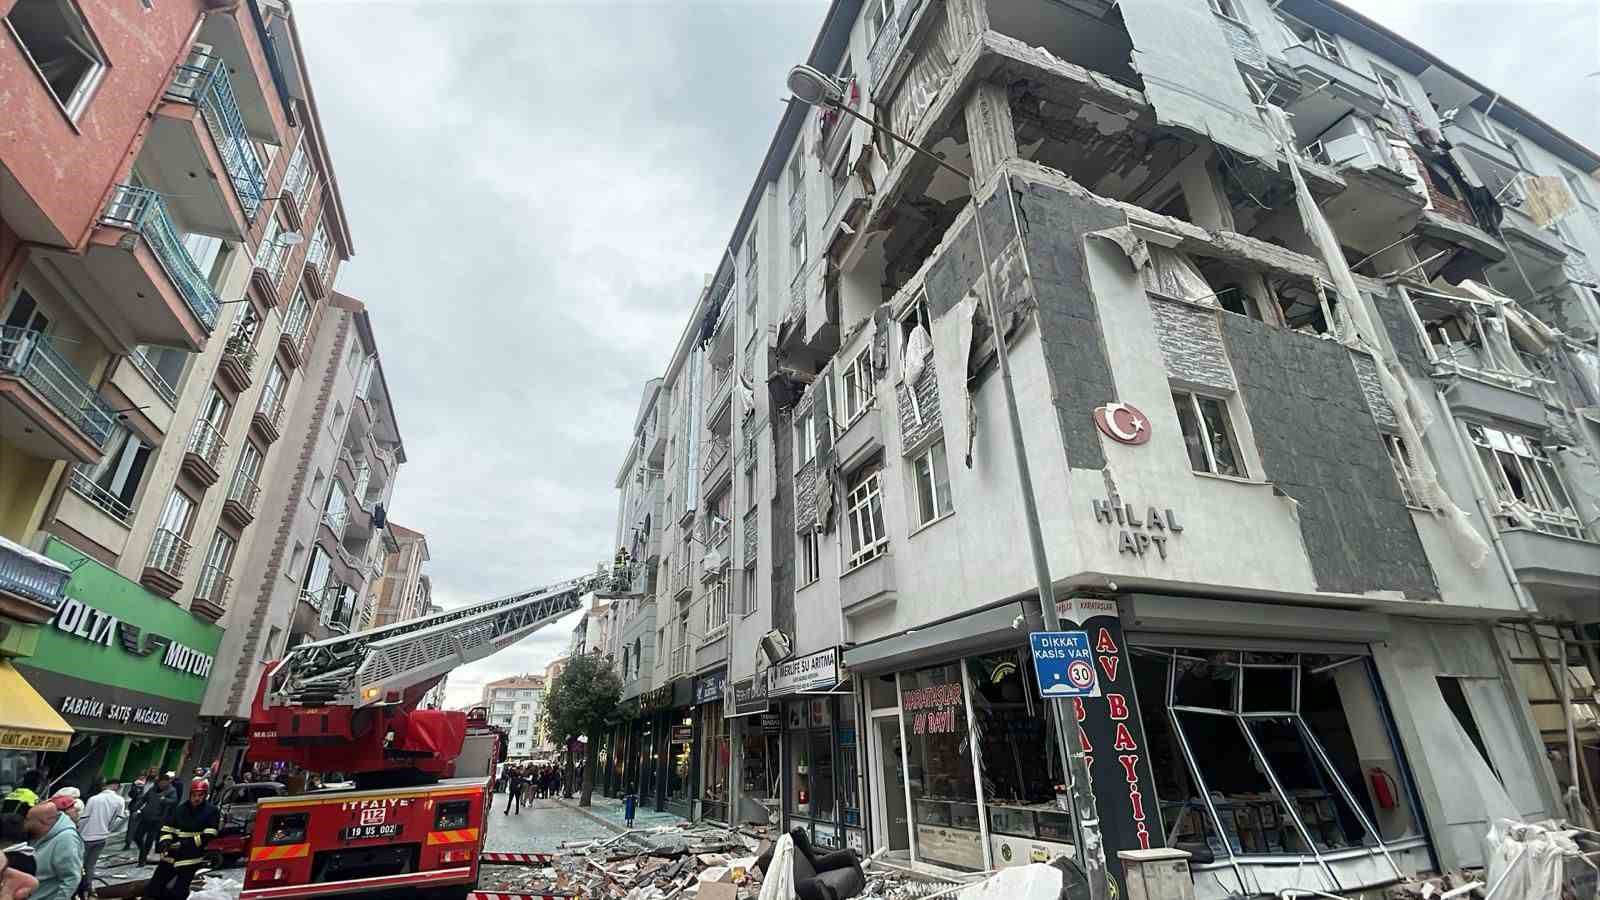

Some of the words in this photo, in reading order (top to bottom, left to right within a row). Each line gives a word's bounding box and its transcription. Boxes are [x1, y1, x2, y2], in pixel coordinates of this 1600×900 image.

[1119, 530, 1167, 560] APT
[1041, 637, 1079, 647] DİKKAT
[164, 640, 214, 678] MOTOR
[1035, 648, 1065, 659] KASİS
[1068, 648, 1090, 658] VAR
[1096, 627, 1119, 681] AV
[801, 659, 811, 673] SU
[1072, 667, 1090, 681] 30
[61, 696, 105, 718] FABRİKA
[363, 809, 384, 820] 112
[352, 827, 361, 836] 19
[365, 826, 376, 835] US
[380, 825, 394, 834] 002
